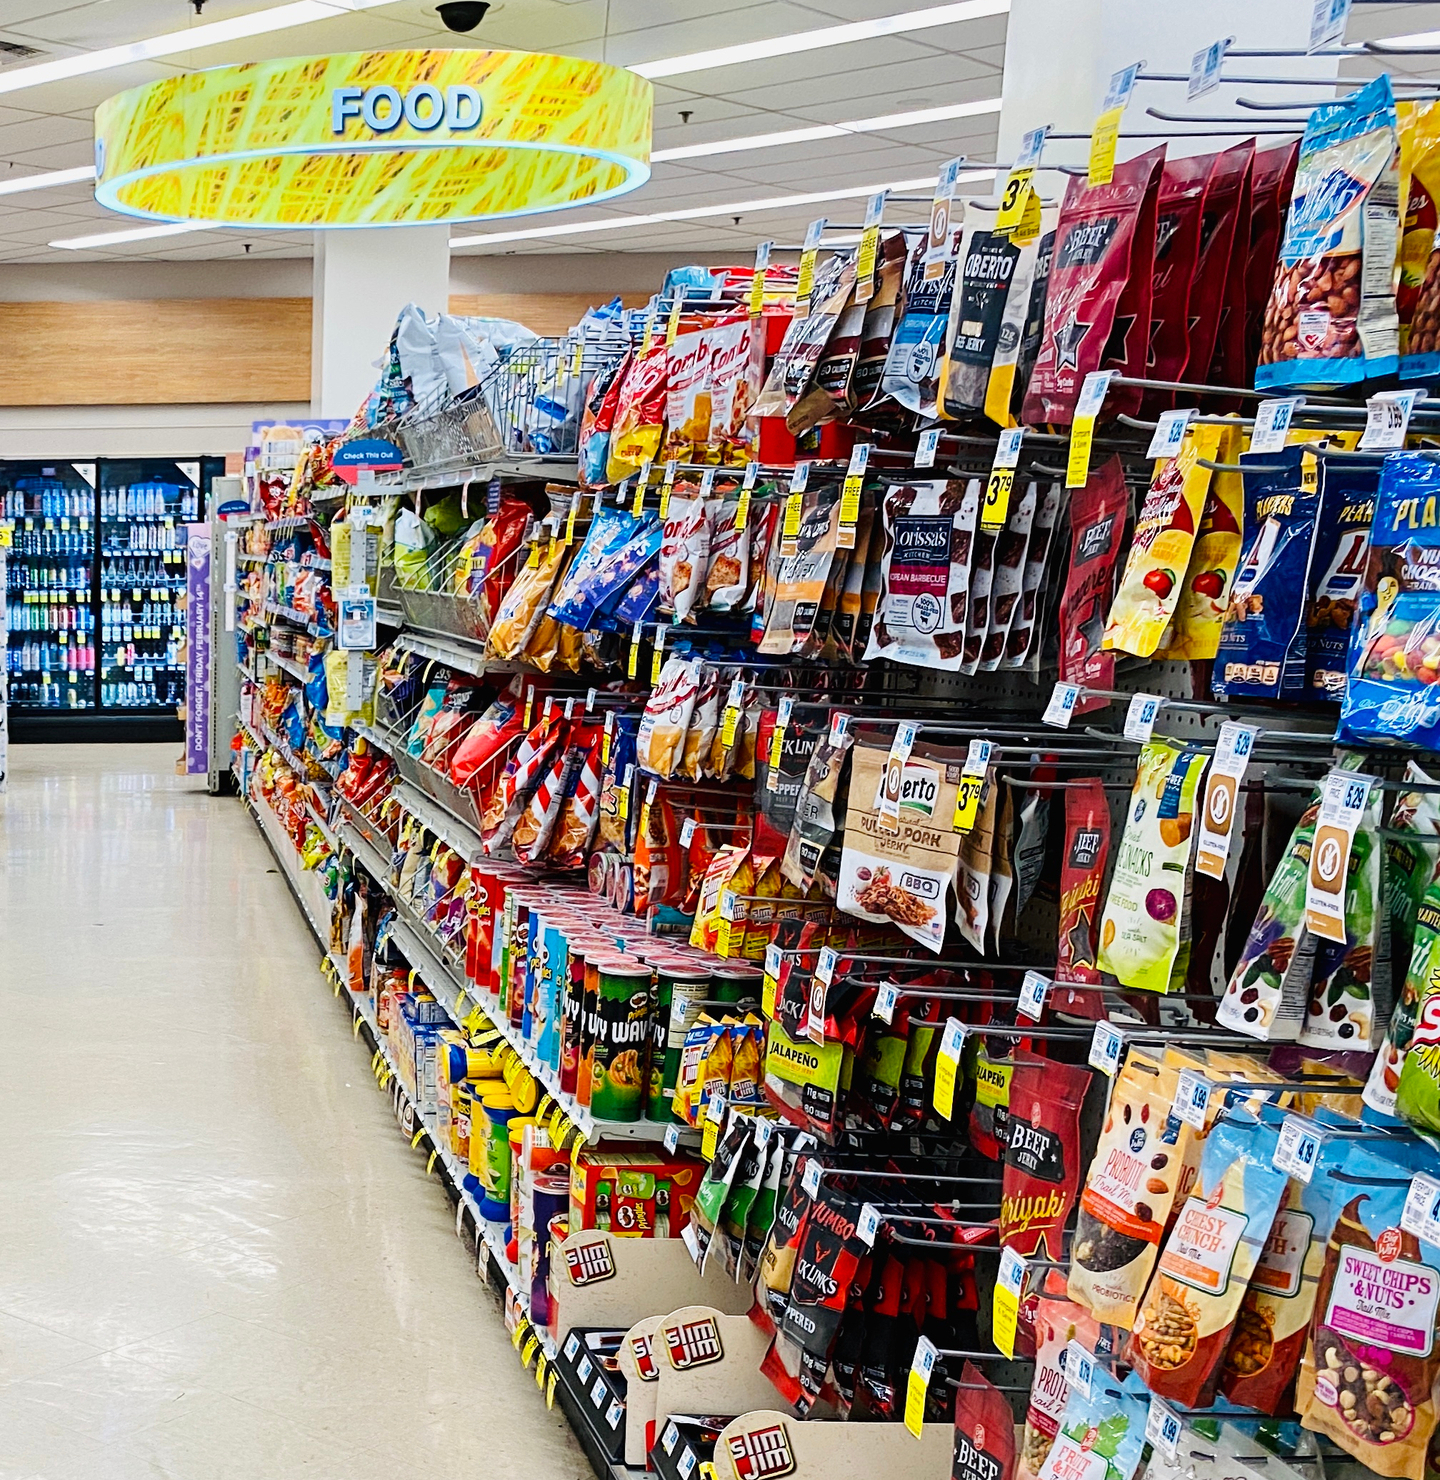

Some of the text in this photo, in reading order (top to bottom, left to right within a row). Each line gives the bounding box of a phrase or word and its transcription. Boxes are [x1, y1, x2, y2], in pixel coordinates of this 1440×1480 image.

[331, 85, 483, 132] FOOD
[861, 237, 876, 249] FREE
[1072, 225, 1110, 252] BEEF
[964, 254, 1015, 280] OBERTO
[711, 330, 750, 371] Comb
[1271, 406, 1288, 430] 5.29
[1169, 422, 1183, 442] 5.29
[343, 451, 394, 461] Check This Out
[1303, 472, 1316, 483] NEW
[845, 487, 860, 497] FREE
[895, 525, 948, 548] Lorissa's
[904, 551, 931, 560] KITCHEN
[911, 573, 946, 585] BARBECUE
[920, 598, 935, 608] 100%
[195, 602, 204, 650] FEBRUARY
[1319, 638, 1344, 650] NUTS
[195, 652, 204, 684] FRIDAY
[195, 685, 205, 722] FORGET,
[1140, 701, 1155, 724] 5.29
[195, 724, 204, 751] DON'T
[1235, 732, 1251, 756] 5.29
[1344, 784, 1364, 809] 5.29
[880, 838, 909, 852] JERKY
[903, 827, 942, 848] PORK
[904, 875, 933, 892] BBQ
[1309, 896, 1340, 912] GLUTEN-FREE
[769, 1041, 819, 1070] JALAPEÑO
[1011, 1123, 1050, 1161] BEEF
[1017, 1152, 1038, 1171] JERKY
[811, 1202, 856, 1241] JUMBO
[1000, 1190, 1066, 1233] eriyaki
[1382, 1232, 1398, 1245] Big
[1379, 1243, 1398, 1258] Win
[808, 1265, 838, 1295] LINK'S
[1345, 1256, 1432, 1295] SWEET CHIPS
[1092, 1284, 1136, 1304] PROBIOTICS
[1356, 1299, 1392, 1320] Trail Mix
[1162, 1414, 1177, 1443] 3.99
[957, 1438, 999, 1480] BEEF
[1058, 1444, 1091, 1472] FRUIT
